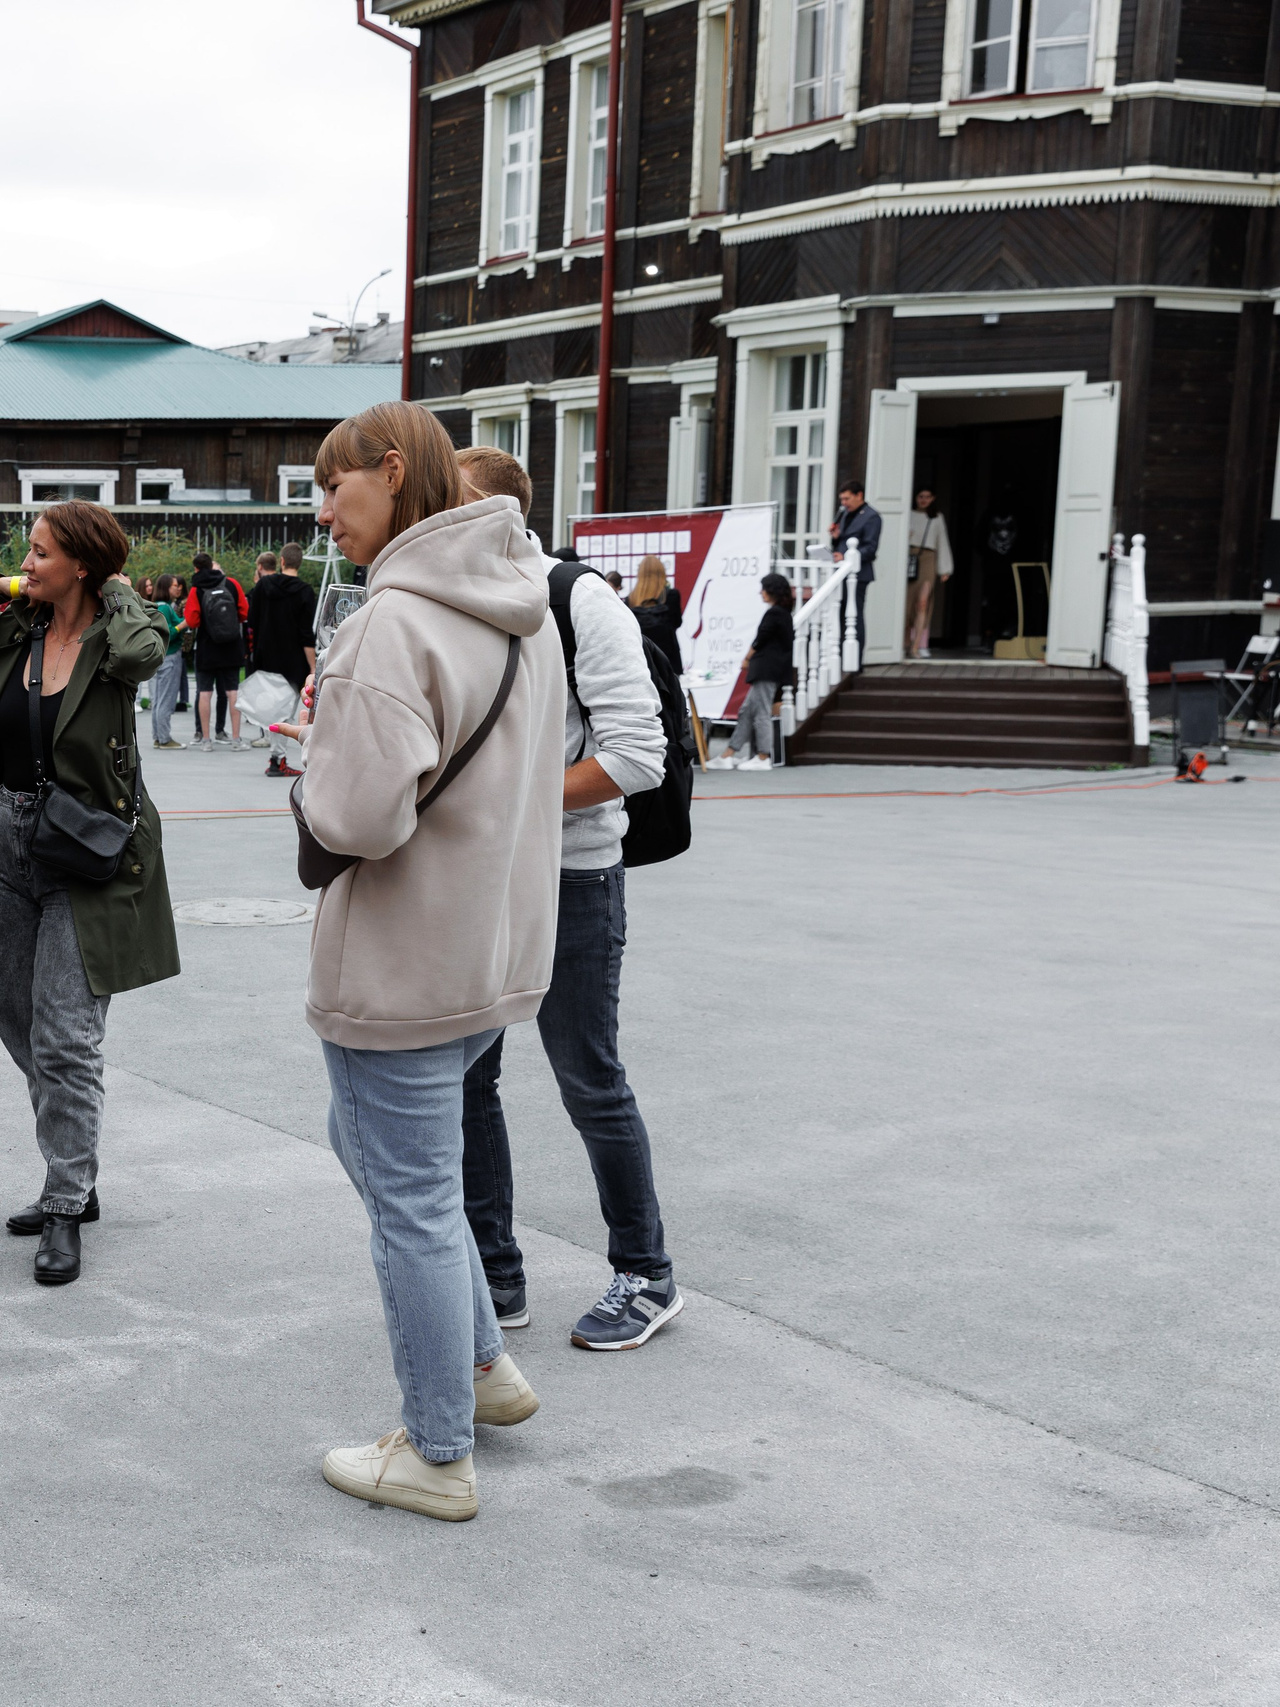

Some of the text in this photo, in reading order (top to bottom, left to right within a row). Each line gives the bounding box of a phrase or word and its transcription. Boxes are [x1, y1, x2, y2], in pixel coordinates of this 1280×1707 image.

[721, 556, 759, 577] 2023
[708, 616, 735, 634] pro
[707, 634, 743, 653] wine
[707, 655, 734, 675] fest
